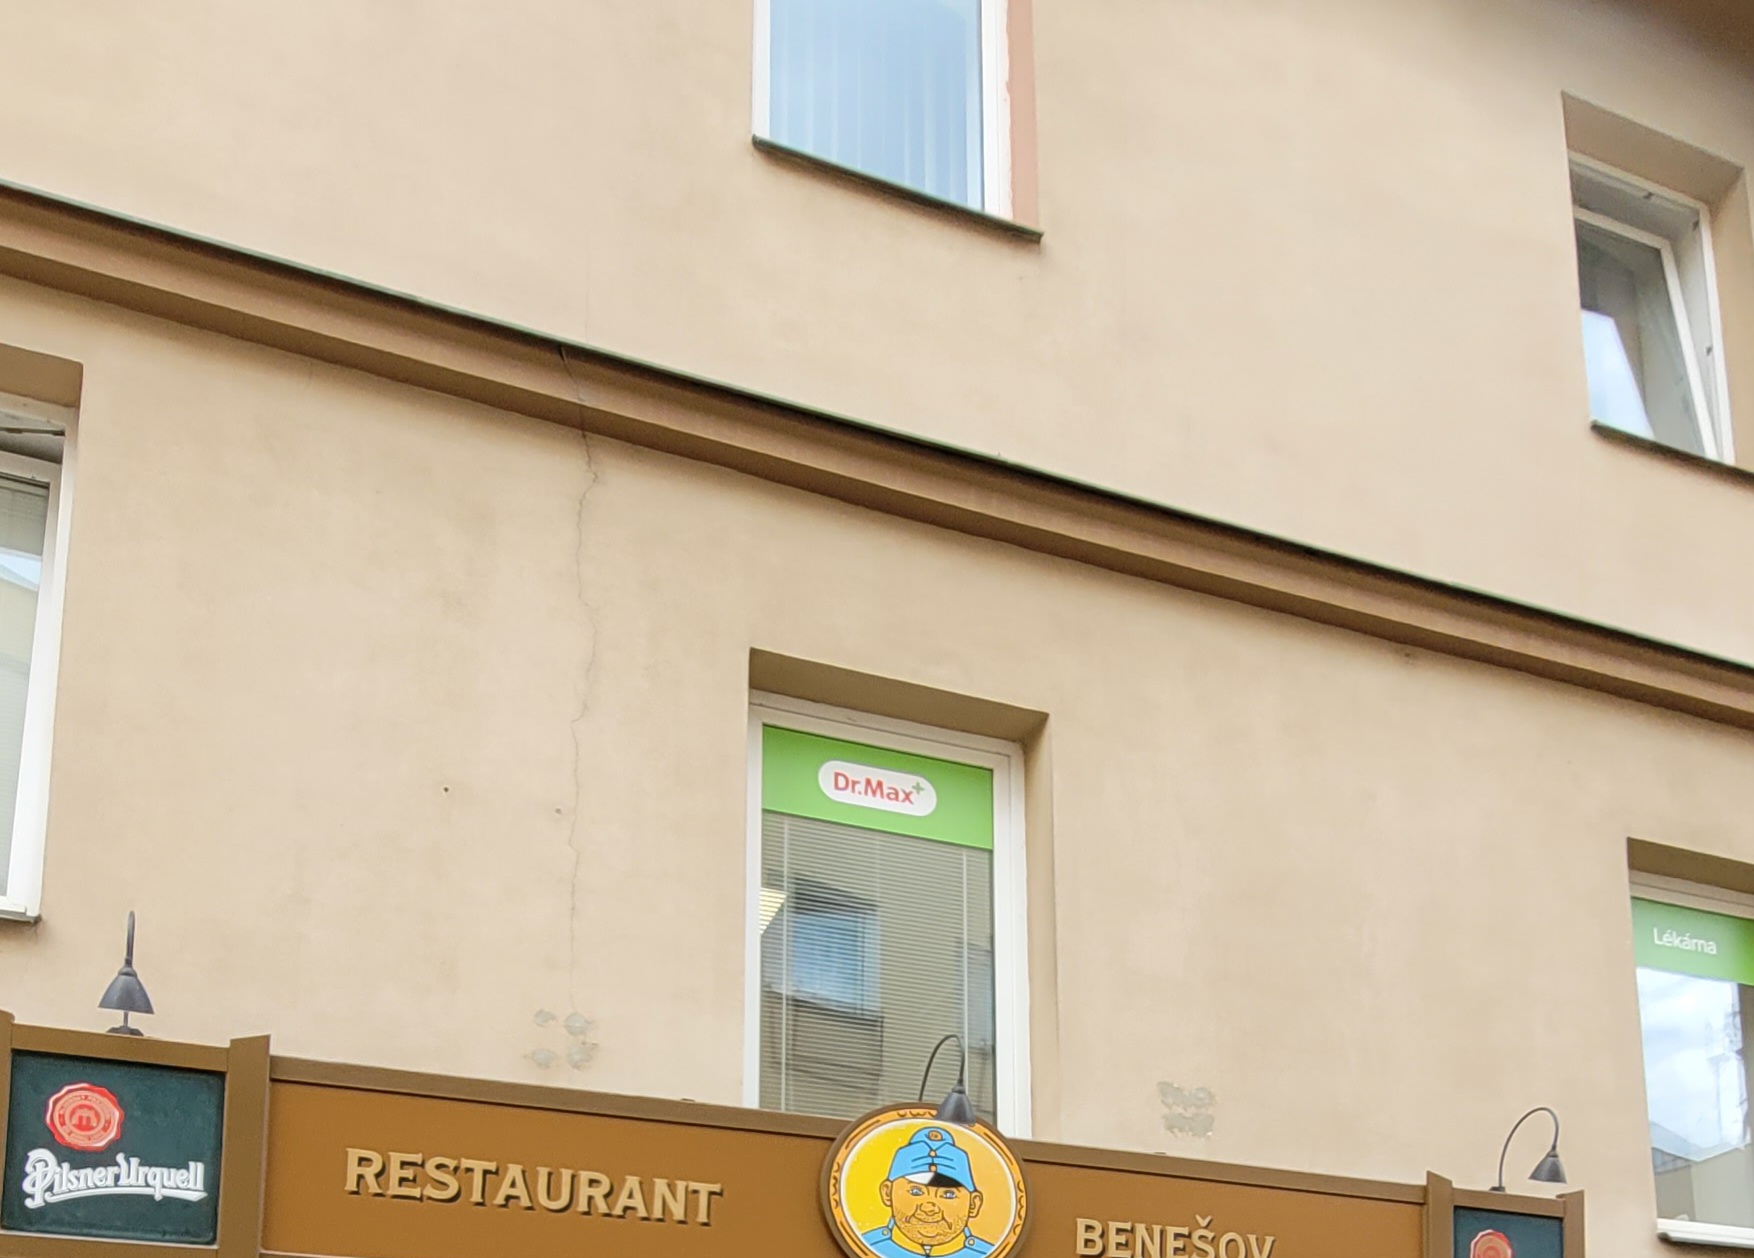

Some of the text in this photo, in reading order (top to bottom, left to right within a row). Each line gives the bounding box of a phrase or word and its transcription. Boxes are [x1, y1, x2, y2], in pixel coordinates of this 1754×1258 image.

[1653, 927, 1717, 955] Lékárna
[22, 1148, 205, 1209] Pilsner Urquell
[344, 1147, 722, 1225] RESTAURANT
